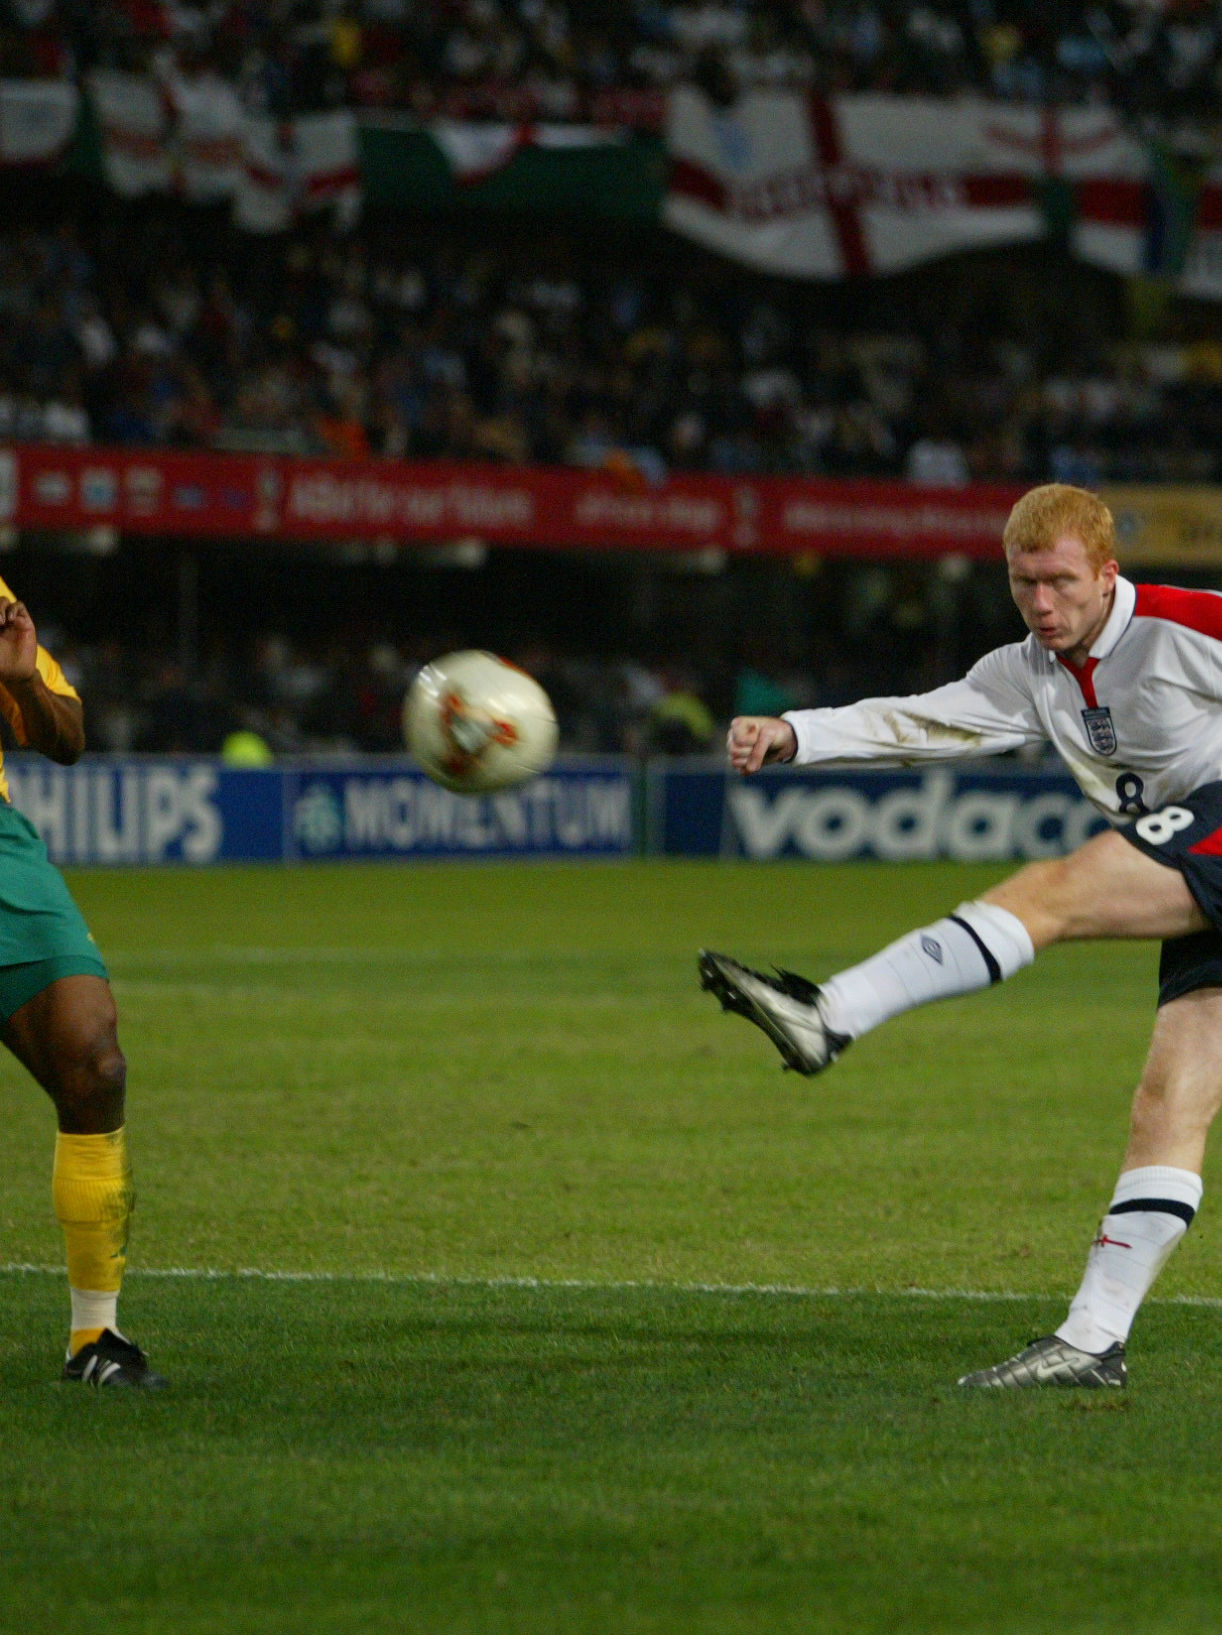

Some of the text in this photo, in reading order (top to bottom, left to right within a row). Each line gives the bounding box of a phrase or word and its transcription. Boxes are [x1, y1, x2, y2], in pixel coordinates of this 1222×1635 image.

[1115, 772, 1152, 813] 8
[344, 778, 632, 850] MOMENTUM
[1135, 805, 1195, 845] 8
